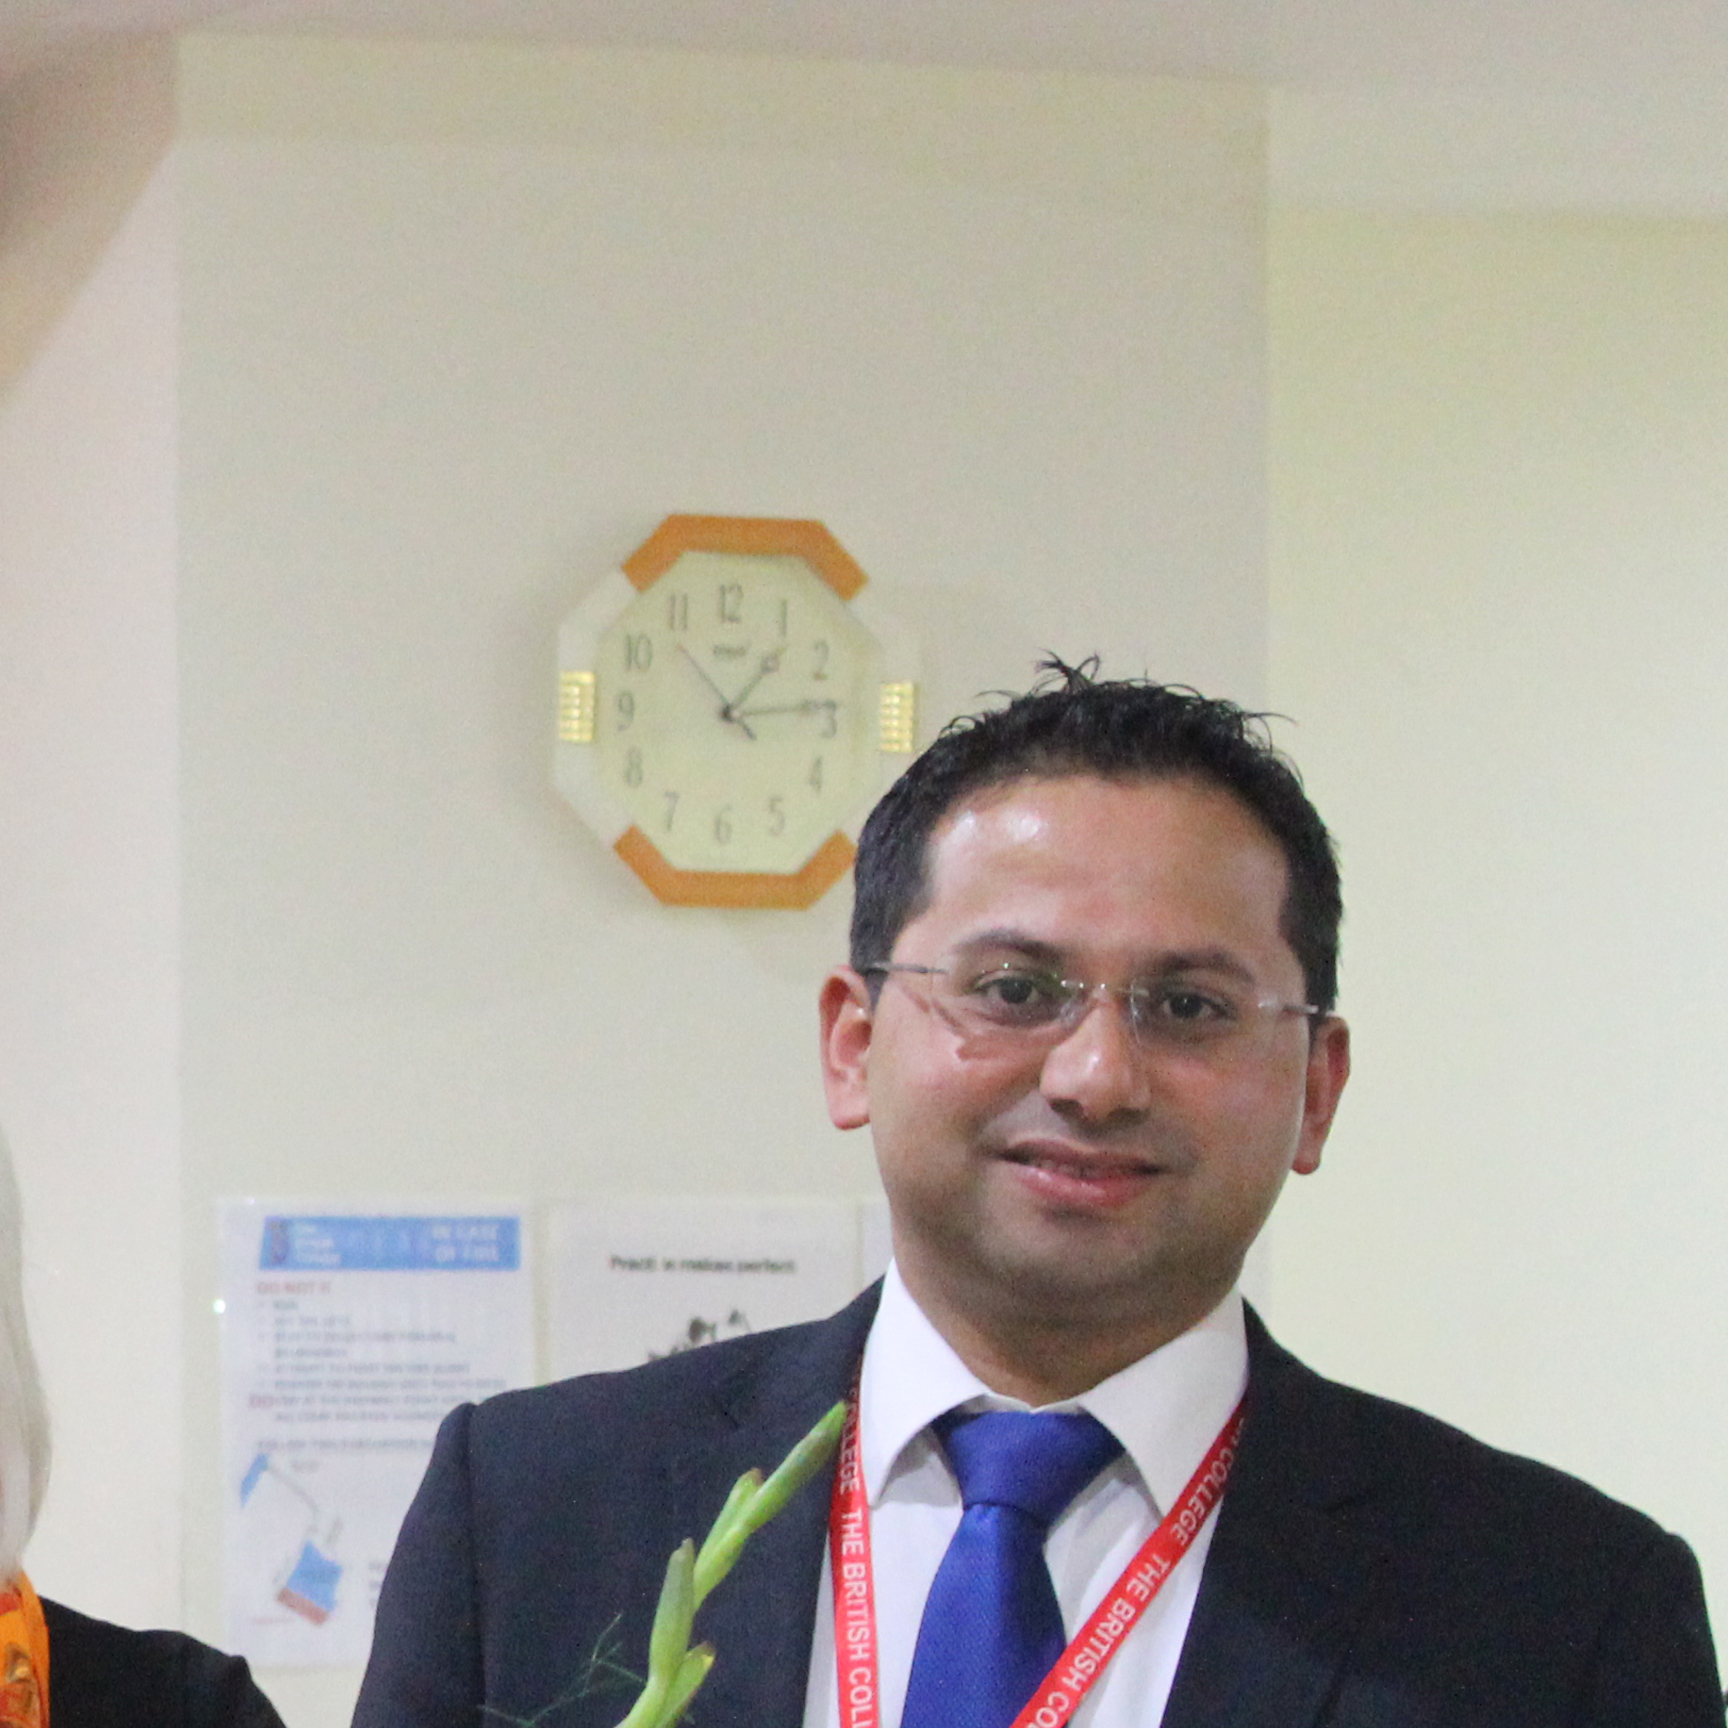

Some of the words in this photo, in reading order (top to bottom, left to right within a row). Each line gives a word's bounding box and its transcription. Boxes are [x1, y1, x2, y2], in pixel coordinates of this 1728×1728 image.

[668, 594, 689, 631] 11
[719, 584, 744, 623] 12
[781, 599, 788, 637] 1
[625, 635, 653, 672] 10
[813, 641, 830, 680] 2
[617, 691, 634, 731] 9
[625, 749, 643, 788] 8
[809, 757, 823, 794] 4
[664, 792, 680, 832] 7
[714, 806, 732, 844] 6
[768, 799, 785, 837] 5
[841, 1507, 864, 1555] THE
[1126, 1553, 1171, 1601] THE
[843, 1562, 871, 1661] BRITISH
[1062, 1597, 1136, 1692] BRITISH
